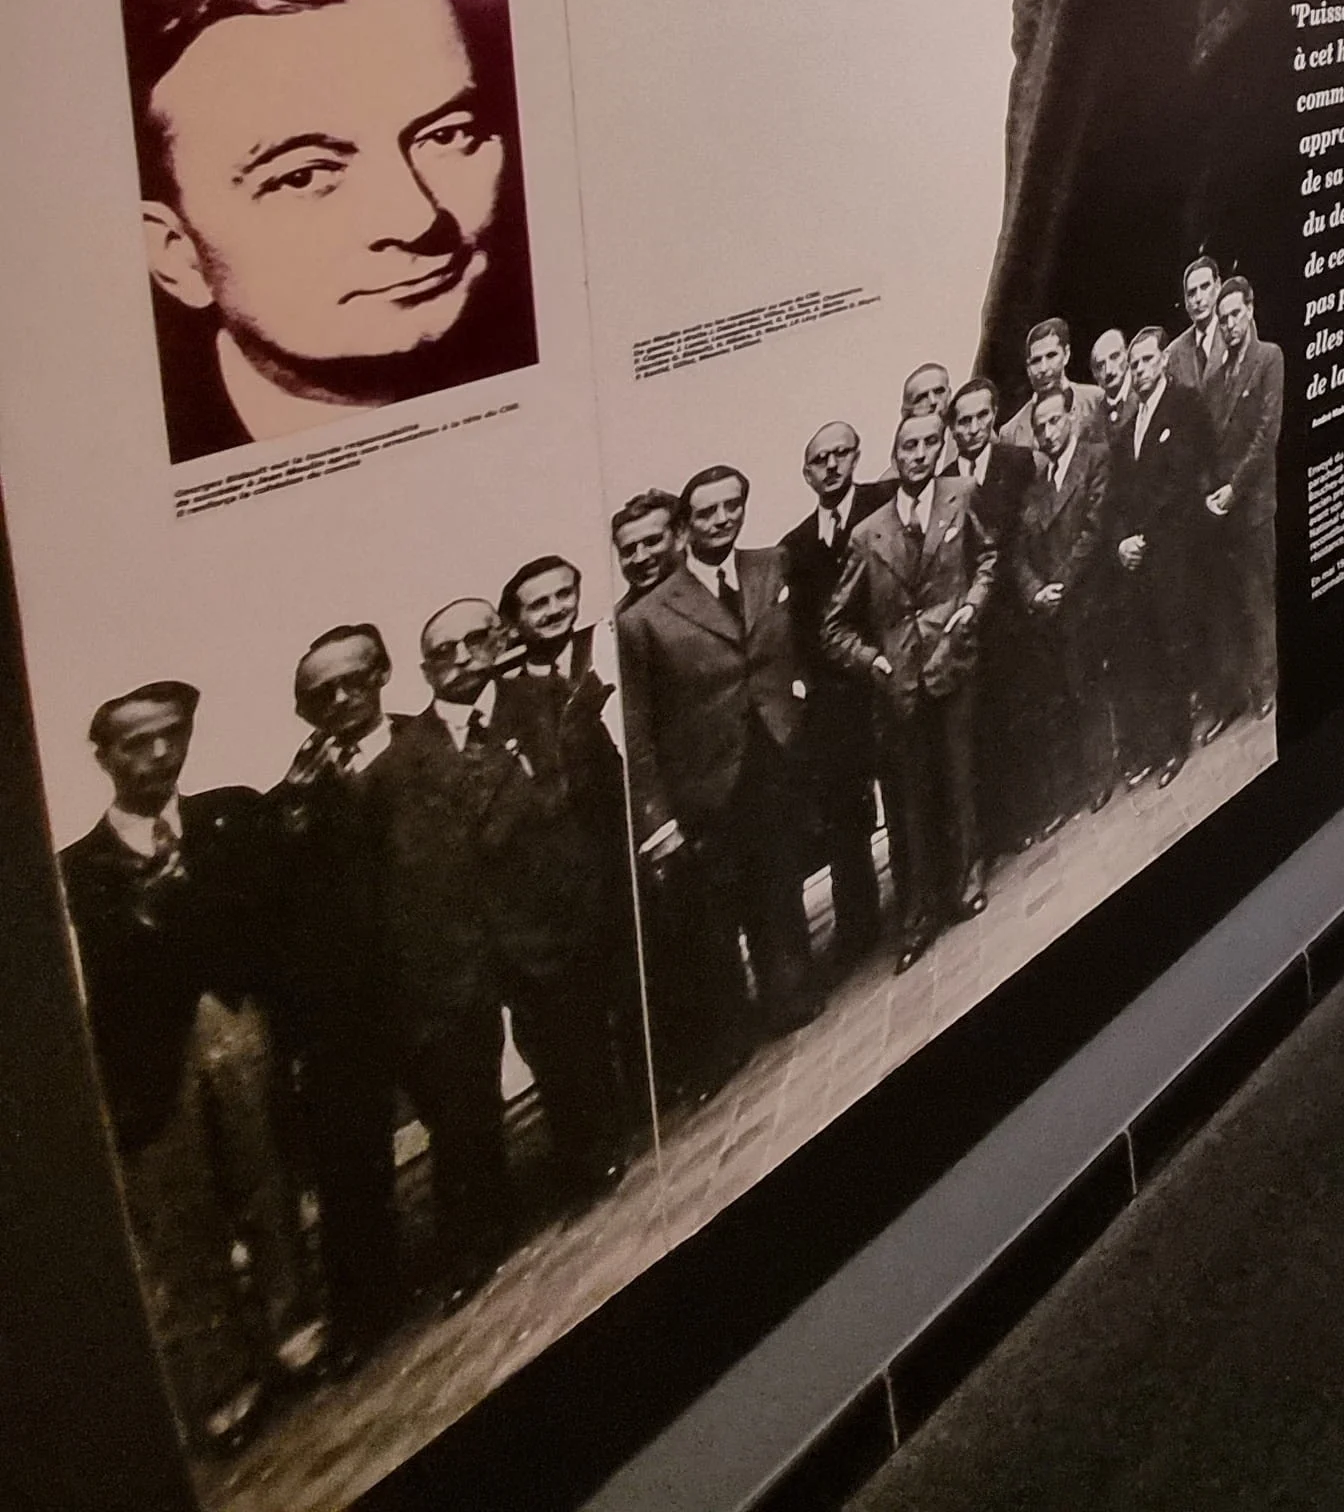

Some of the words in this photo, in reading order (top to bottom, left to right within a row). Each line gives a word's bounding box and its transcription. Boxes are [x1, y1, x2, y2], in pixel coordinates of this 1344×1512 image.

[1294, 46, 1306, 71] à
[1309, 43, 1334, 68] cet
[1301, 169, 1321, 196] de
[1325, 169, 1344, 188] sa
[1303, 210, 1326, 237] du
[1304, 251, 1324, 279] de
[1304, 294, 1335, 326] pas
[1306, 328, 1344, 360] elles
[1306, 373, 1327, 401] de
